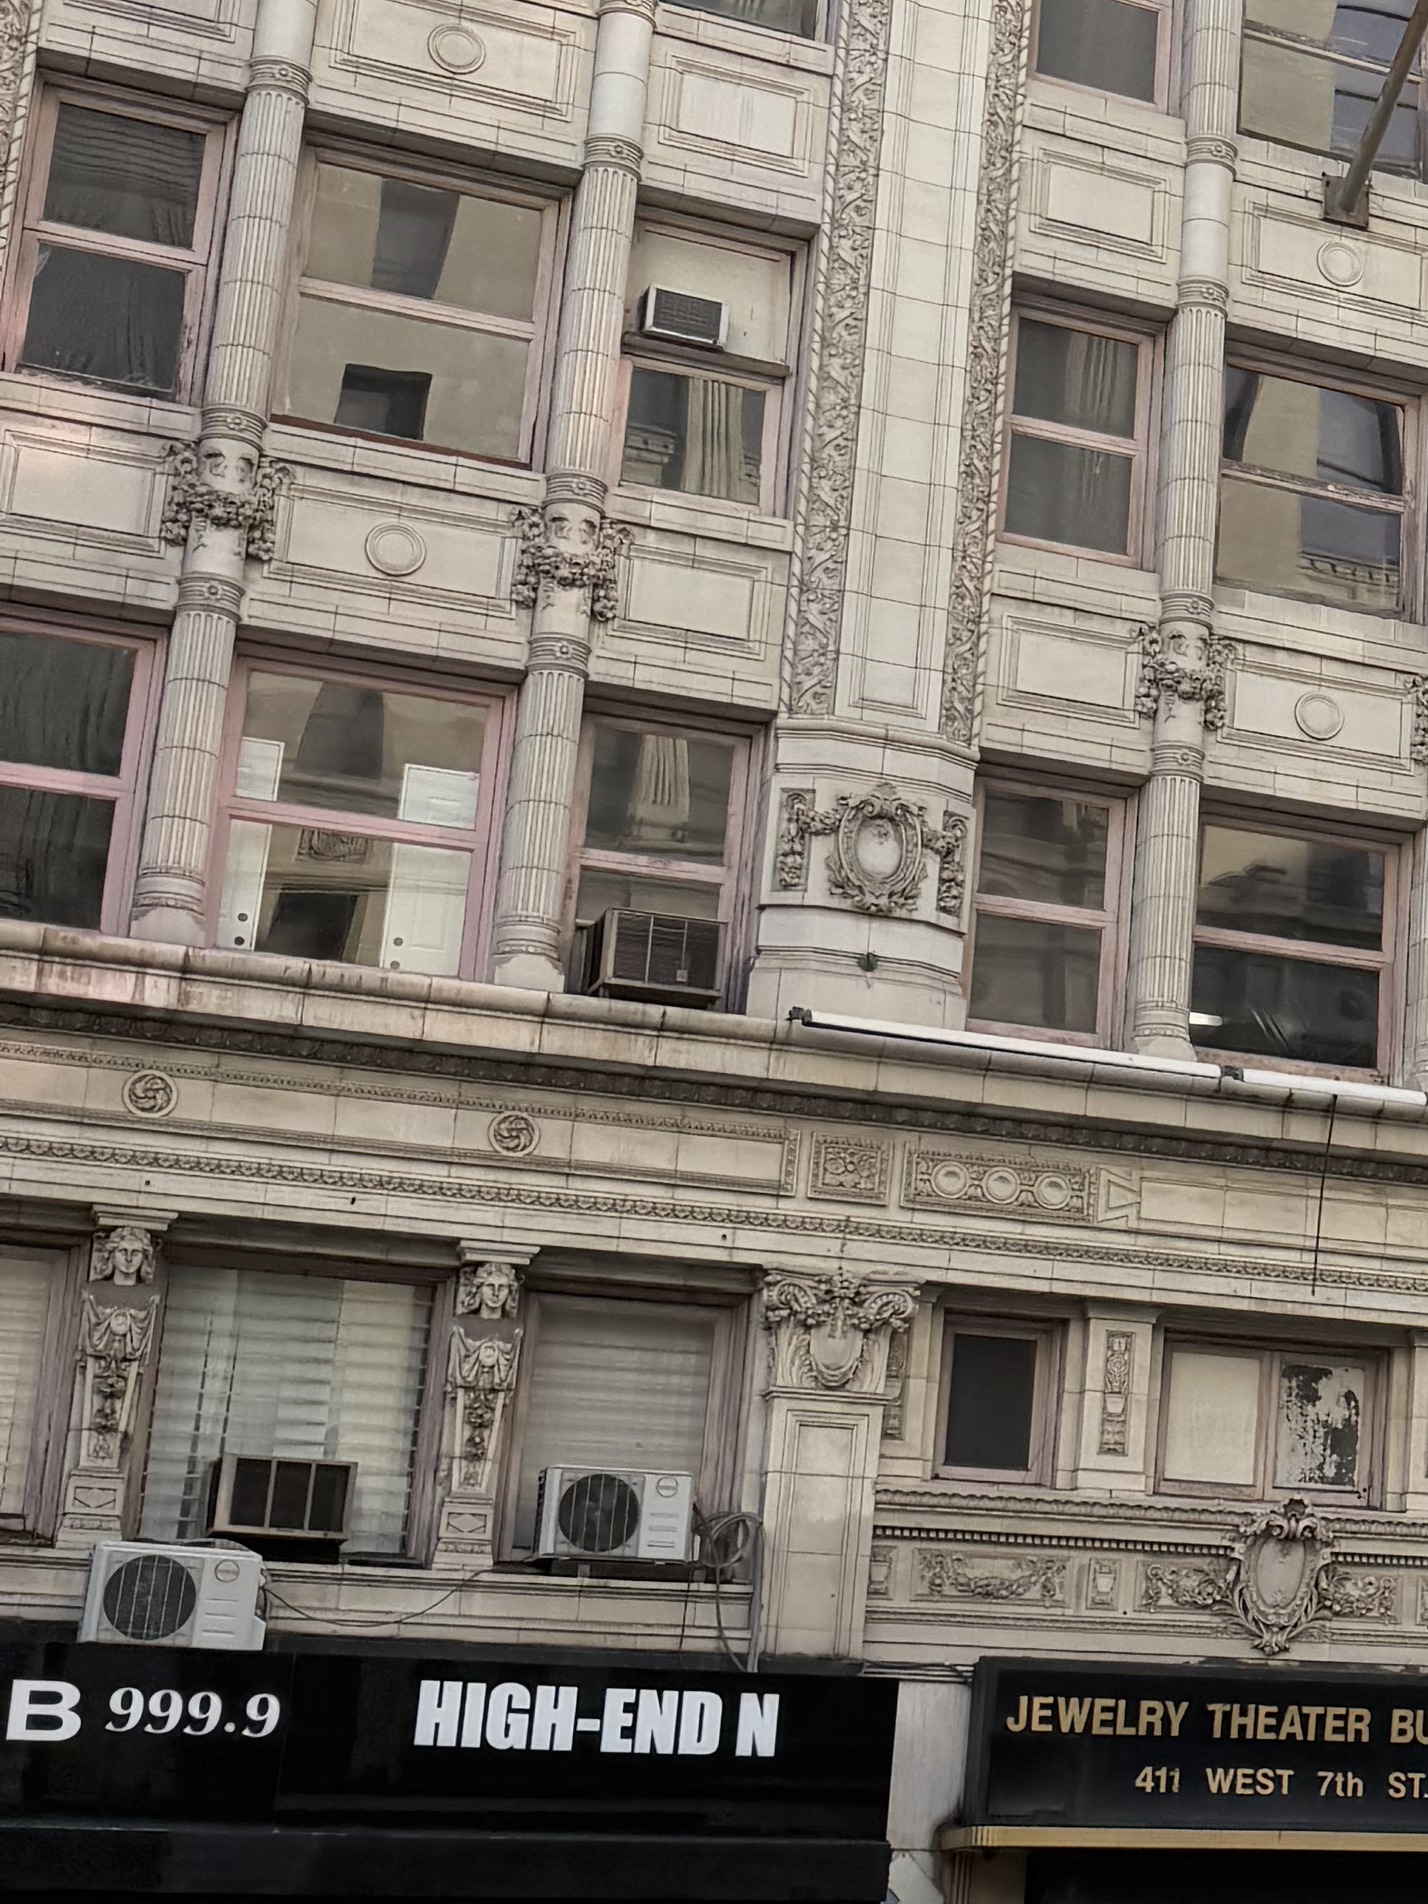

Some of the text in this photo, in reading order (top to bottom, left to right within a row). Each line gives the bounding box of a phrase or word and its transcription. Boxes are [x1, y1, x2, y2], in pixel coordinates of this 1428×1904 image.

[5, 1679, 282, 1742] B 999.9
[413, 1679, 780, 1758] HIGH-END N
[1005, 1694, 1189, 1738] JEWELRY
[1206, 1702, 1370, 1743] THEATER
[1134, 1766, 1181, 1795] 411
[1206, 1767, 1293, 1797] WEST
[1316, 1769, 1365, 1799] 7th
